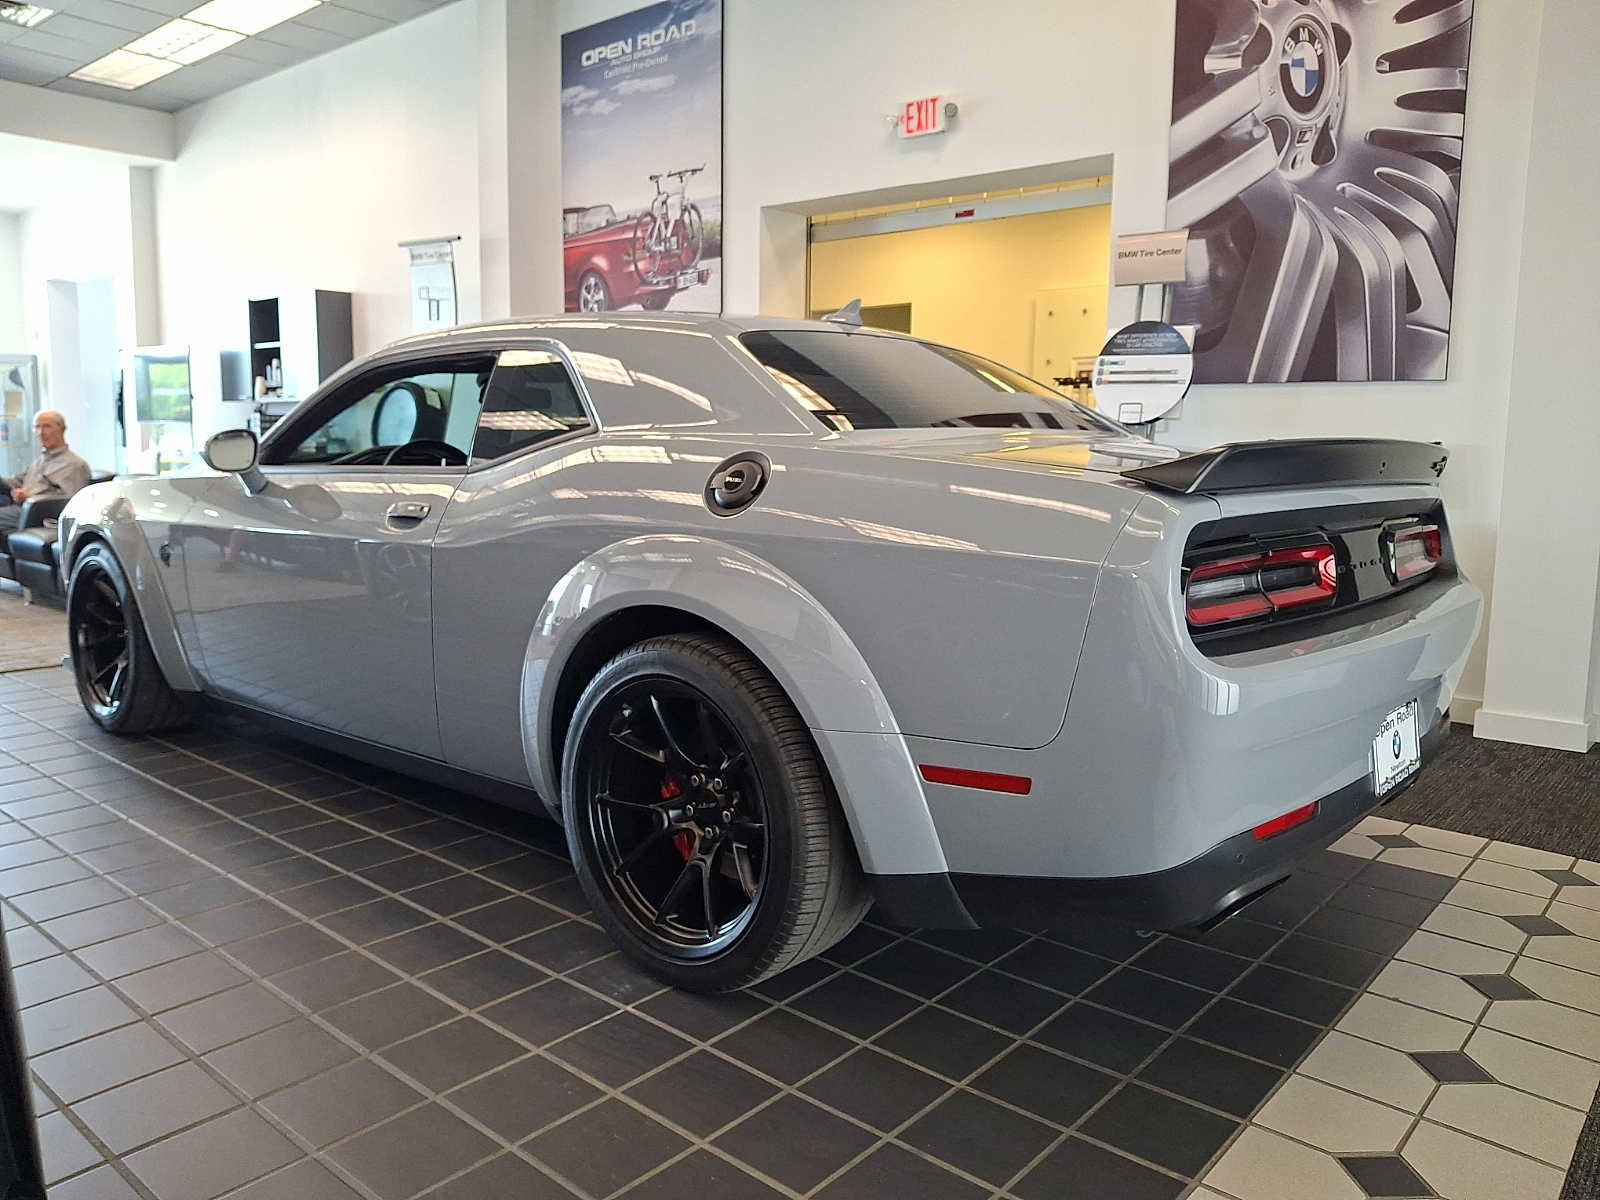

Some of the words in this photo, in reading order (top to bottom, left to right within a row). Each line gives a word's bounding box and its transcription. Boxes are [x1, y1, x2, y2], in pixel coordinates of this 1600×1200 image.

[581, 38, 633, 67] OPEN
[637, 20, 697, 48] ROAD
[1284, 27, 1324, 56] BMW
[906, 97, 938, 133] EXIT
[1118, 250, 1138, 259] BMW
[1140, 249, 1154, 258] Tire
[1156, 248, 1183, 256] Center
